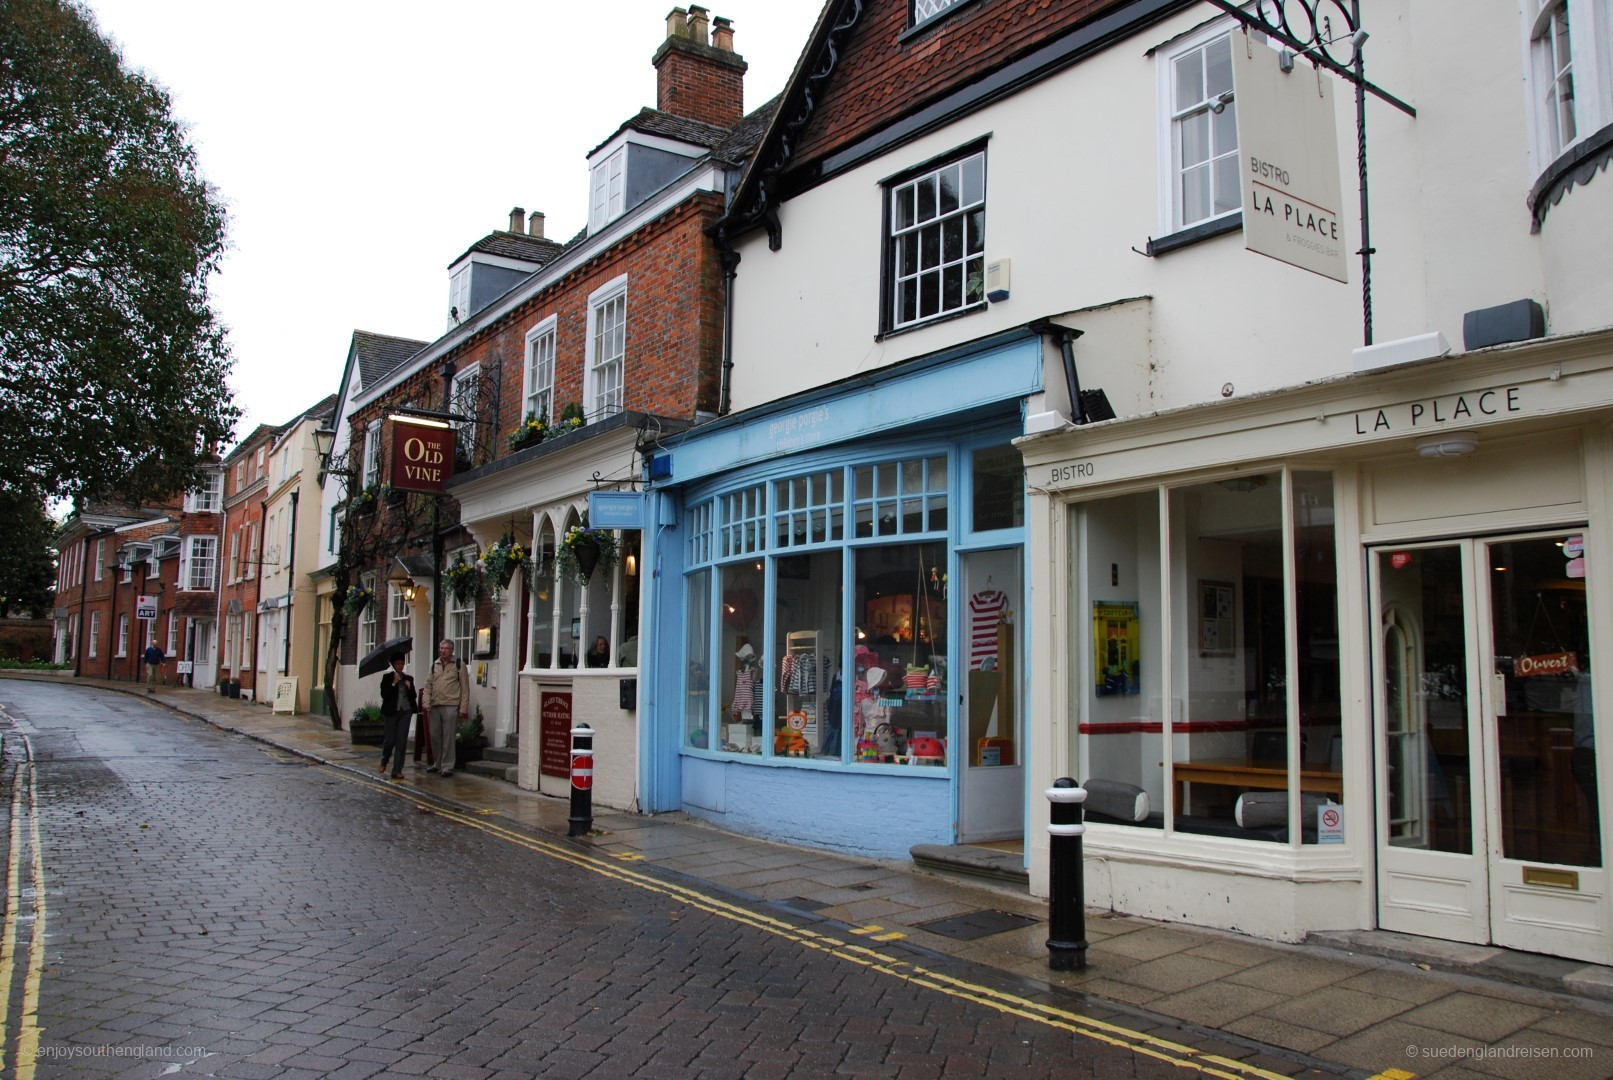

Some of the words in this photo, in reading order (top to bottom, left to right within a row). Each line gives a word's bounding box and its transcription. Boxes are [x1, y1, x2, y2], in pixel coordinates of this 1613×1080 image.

[1250, 157, 1290, 186] BISTRO
[1253, 191, 1275, 216] LA
[1284, 203, 1338, 240] PLACE
[1325, 247, 1339, 258] BAR
[1355, 410, 1390, 435] LA
[1411, 387, 1521, 426] PLACE
[769, 414, 797, 439] georgie
[798, 404, 829, 432] porgie's
[427, 441, 441, 450] THE
[405, 465, 441, 482] VINE
[1051, 462, 1094, 482] BISTRO
[1521, 655, 1568, 673] Ouvert
